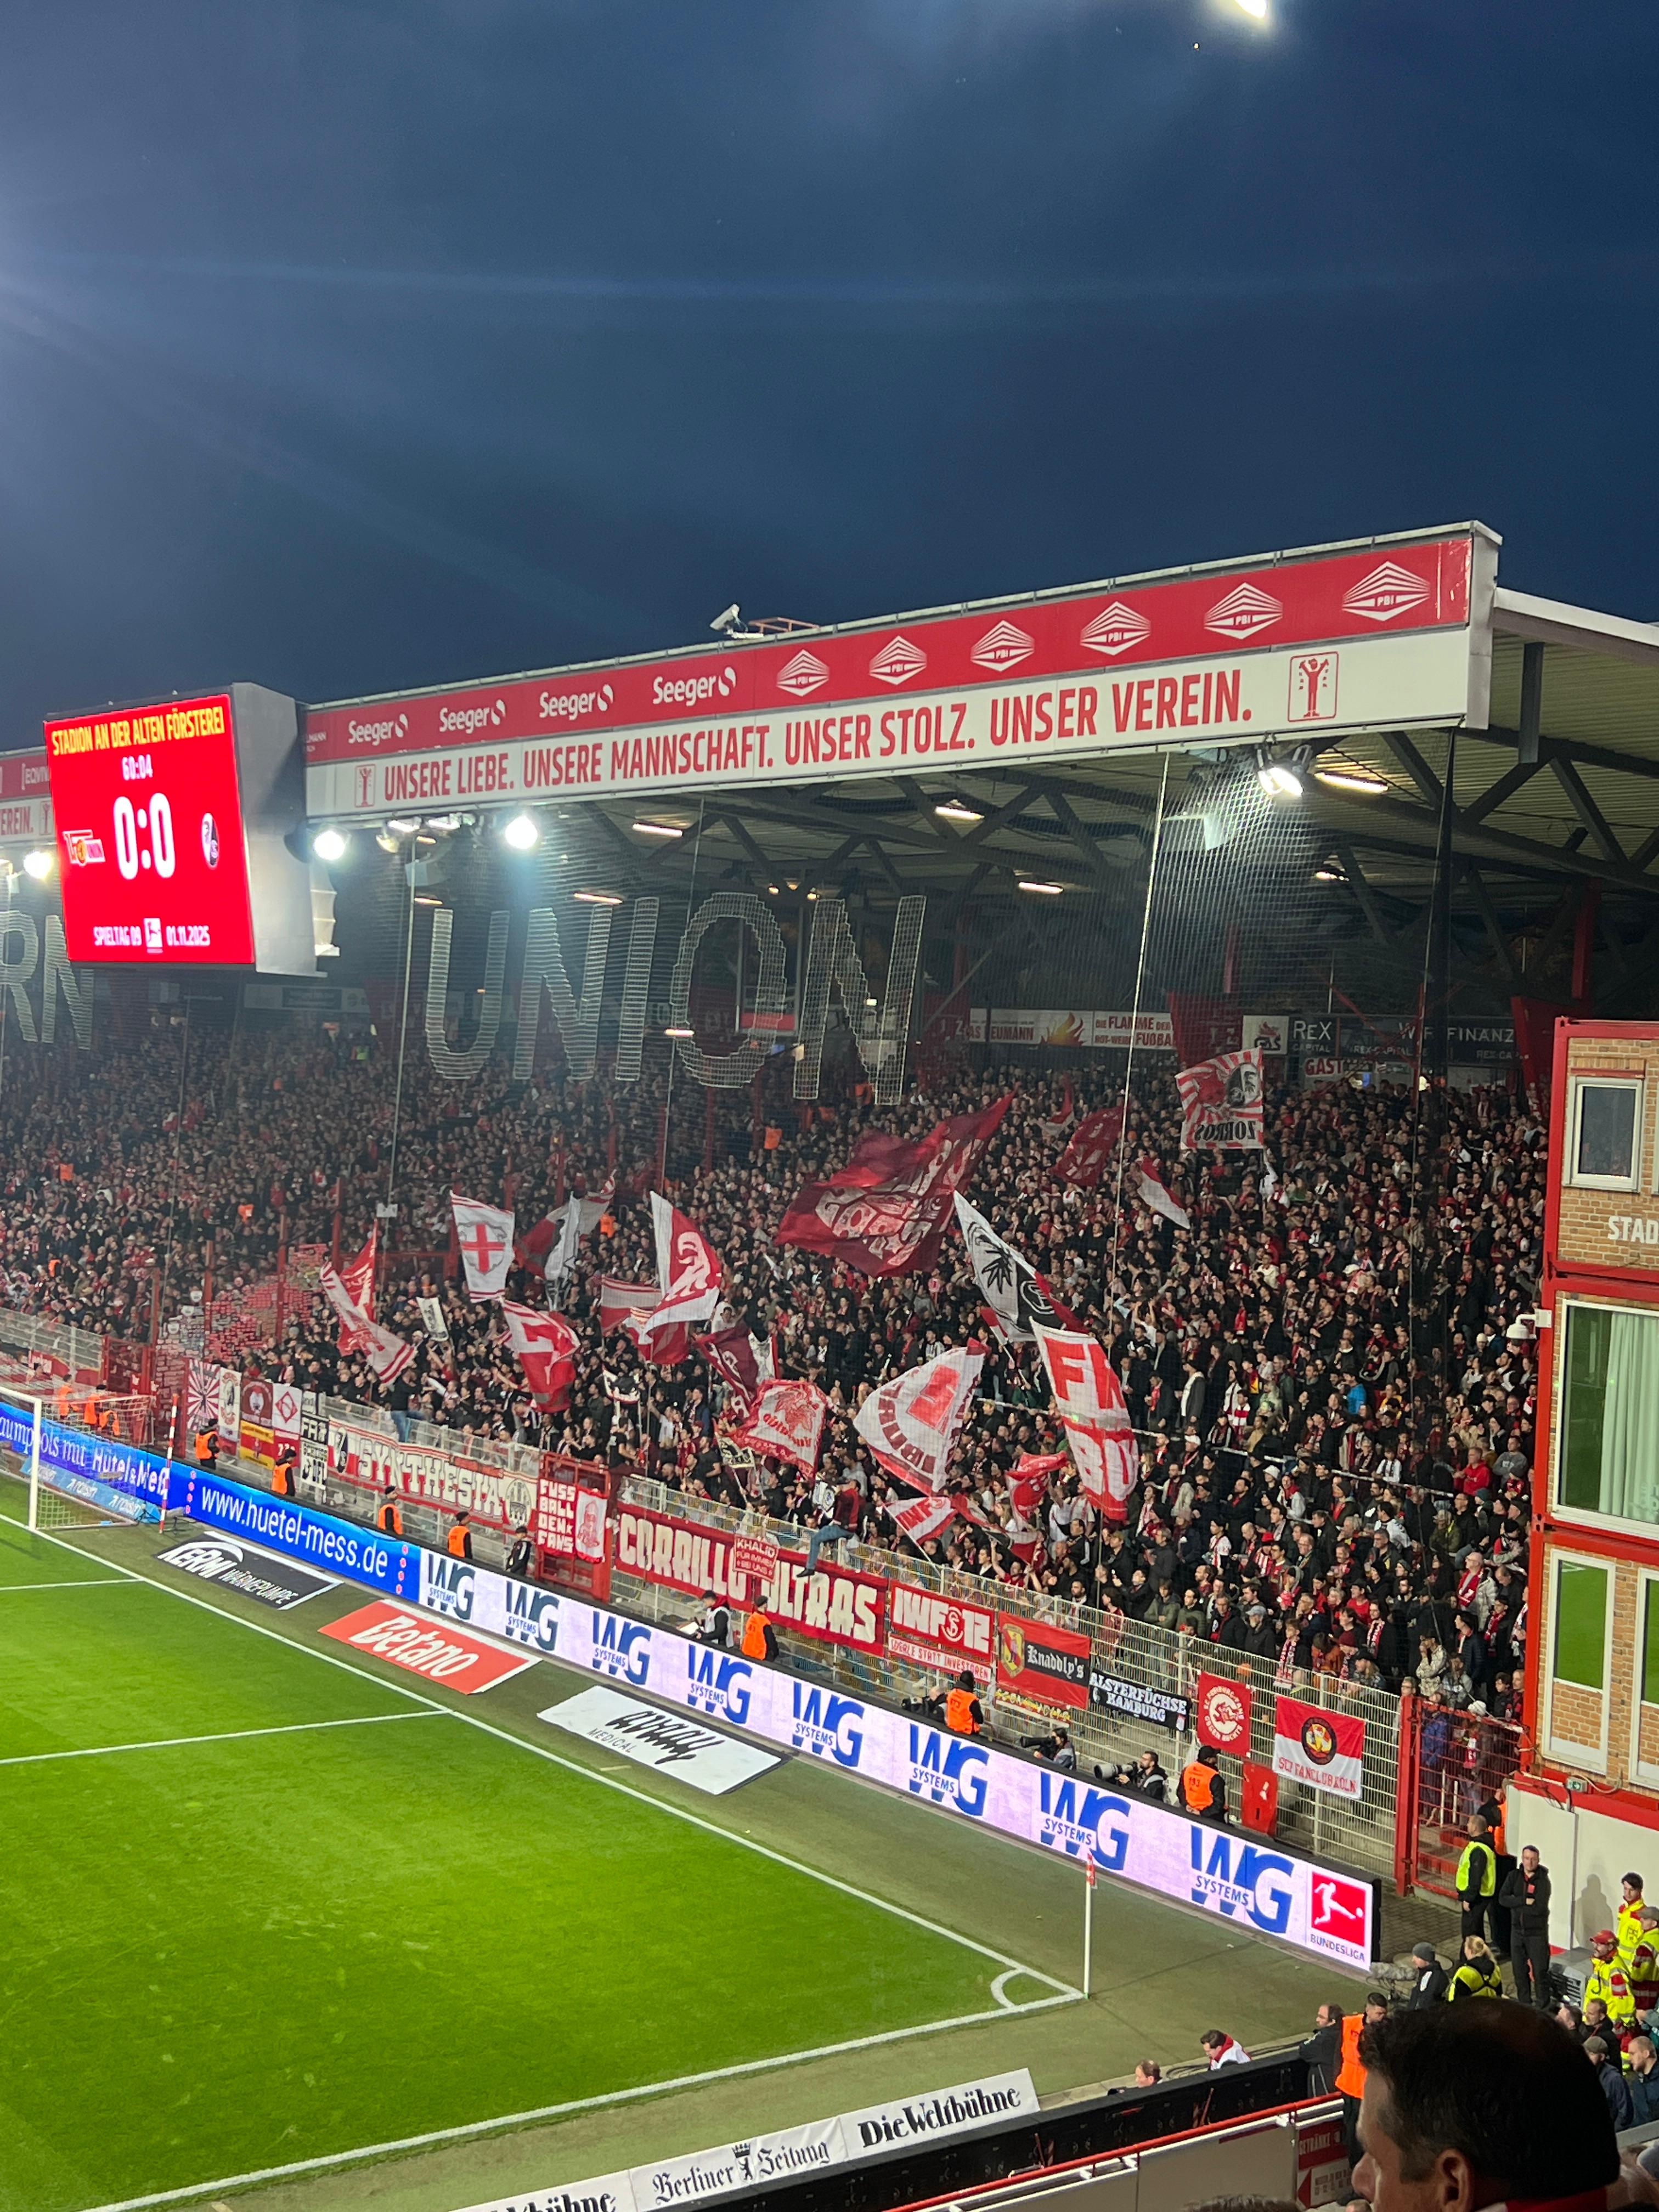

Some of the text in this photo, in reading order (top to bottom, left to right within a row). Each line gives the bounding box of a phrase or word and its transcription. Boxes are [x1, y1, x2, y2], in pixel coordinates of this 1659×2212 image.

[1377, 594, 1396, 607] PBI
[1235, 614, 1251, 626] PBI
[1108, 632, 1122, 642] PBI
[995, 649, 1009, 659] PBI
[653, 675, 716, 706] Seeger
[439, 707, 490, 733] Seeger
[539, 691, 596, 720] Seeger
[52, 706, 225, 755] STADION AN DER ALTEN FÖRSTEREI
[348, 720, 396, 746] Seeger
[384, 763, 450, 801] UNSERE
[457, 753, 515, 795] LIEBE.
[523, 742, 603, 788] UNSERE
[611, 725, 773, 780] MANNSCHAFT.
[786, 714, 871, 766] UNSER
[880, 703, 975, 757] STOLZ.
[990, 687, 1097, 746] UNSER
[1112, 669, 1251, 732] VEREIN.
[114, 792, 176, 880] 0:0
[93, 926, 129, 946] SPIELTAG
[166, 925, 210, 946] 01.11.2025
[425, 892, 927, 1105] UNION
[1293, 1043, 1330, 1052] CAPITAL
[1607, 1215, 1659, 1244] STAD
[359, 1438, 503, 1517] SYNTHESIA
[540, 1479, 576, 1502] FUSS
[539, 1498, 575, 1519] BALL
[202, 1487, 388, 1577] www.huetel-mess.de
[538, 1515, 566, 1535] DEN
[537, 1531, 574, 1554] FANS
[737, 1538, 775, 1558] KHALID
[158, 1547, 238, 1578] KERMI
[428, 1554, 475, 1620] WG
[430, 1587, 455, 1604] SYSTEMS
[505, 1581, 560, 1651] WG
[761, 1560, 877, 1644] ULTRAS
[508, 1616, 537, 1634] SYSTEMS
[963, 1611, 990, 1652] 12
[348, 1615, 479, 1677] Betano
[592, 1610, 652, 1685] WG
[595, 1647, 625, 1668] SYSTEMS
[918, 1647, 941, 1664] STATT
[687, 1644, 753, 1725] WG
[691, 1683, 724, 1704] SYSTEMS
[1089, 1672, 1188, 1716] ALSTERFÜCHSE
[1106, 1692, 1166, 1722] HAMBURG
[792, 1680, 865, 1768] WG
[795, 1722, 833, 1746] SYSTEMS
[586, 1727, 637, 1754] MEDICAL
[909, 1723, 990, 1816] WG
[913, 1767, 955, 1793] SYSTEMS
[1295, 1763, 1333, 1787] FANCLUB
[1040, 1771, 1131, 1871] WG
[1044, 1818, 1092, 1846] SYSTEMS
[1190, 1825, 1294, 1934] WG
[1195, 1875, 1249, 1906] SYSTEMS
[1310, 1933, 1365, 1963] BUNDESLIGA
[858, 2086, 1020, 2148] Die Weltbühne
[652, 2162, 735, 2207] Berliner
[756, 2138, 831, 2183] Zeitung
